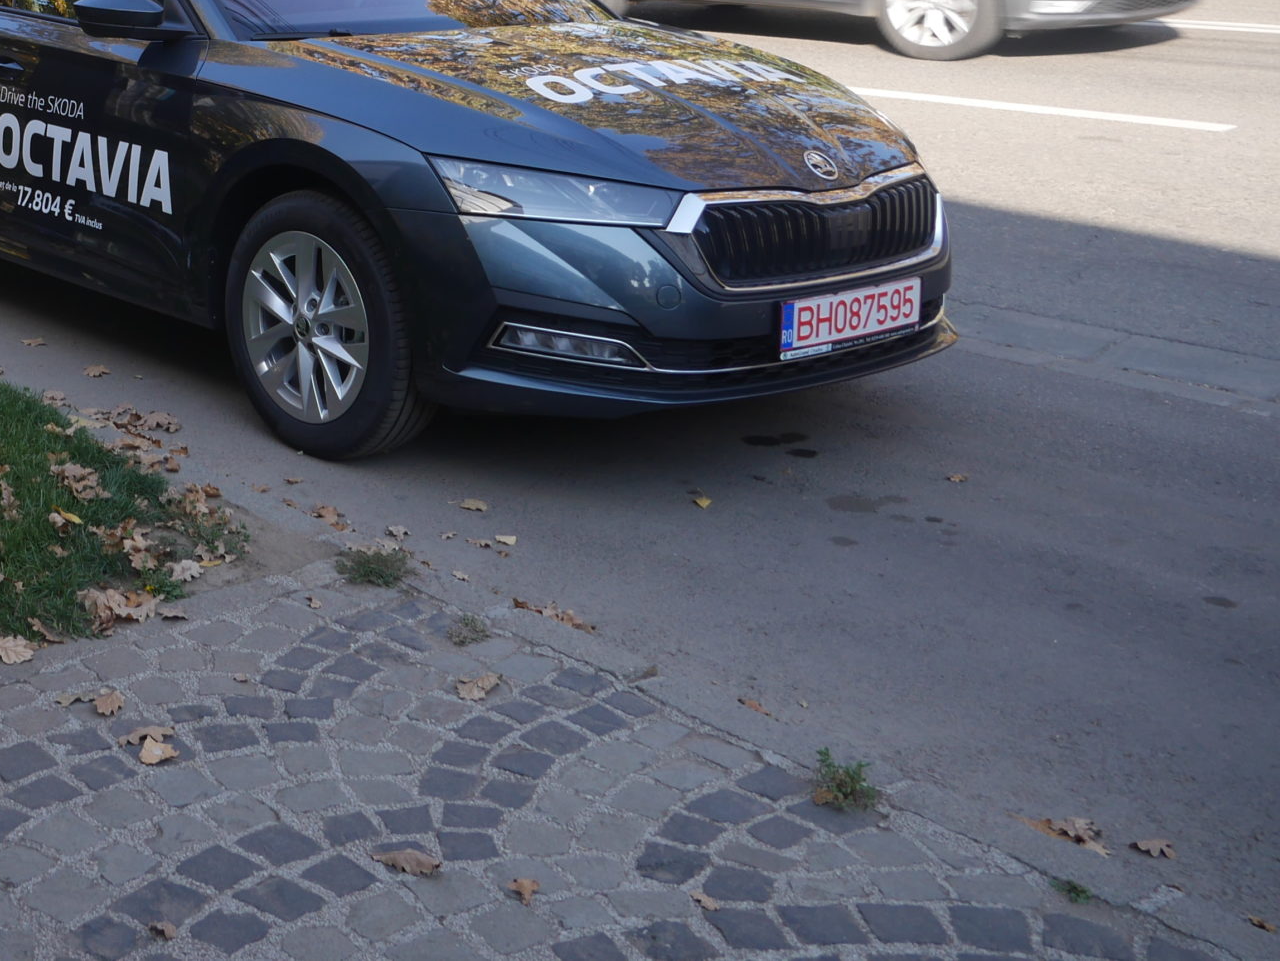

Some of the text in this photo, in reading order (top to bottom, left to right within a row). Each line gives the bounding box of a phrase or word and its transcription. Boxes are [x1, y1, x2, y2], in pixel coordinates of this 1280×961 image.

[525, 59, 807, 104] OCTAVIA
[0, 86, 85, 120] Drive the SKODA
[17, 185, 76, 221] 17.804 €
[75, 213, 103, 230] TVA inclus
[782, 328, 793, 344] RO
